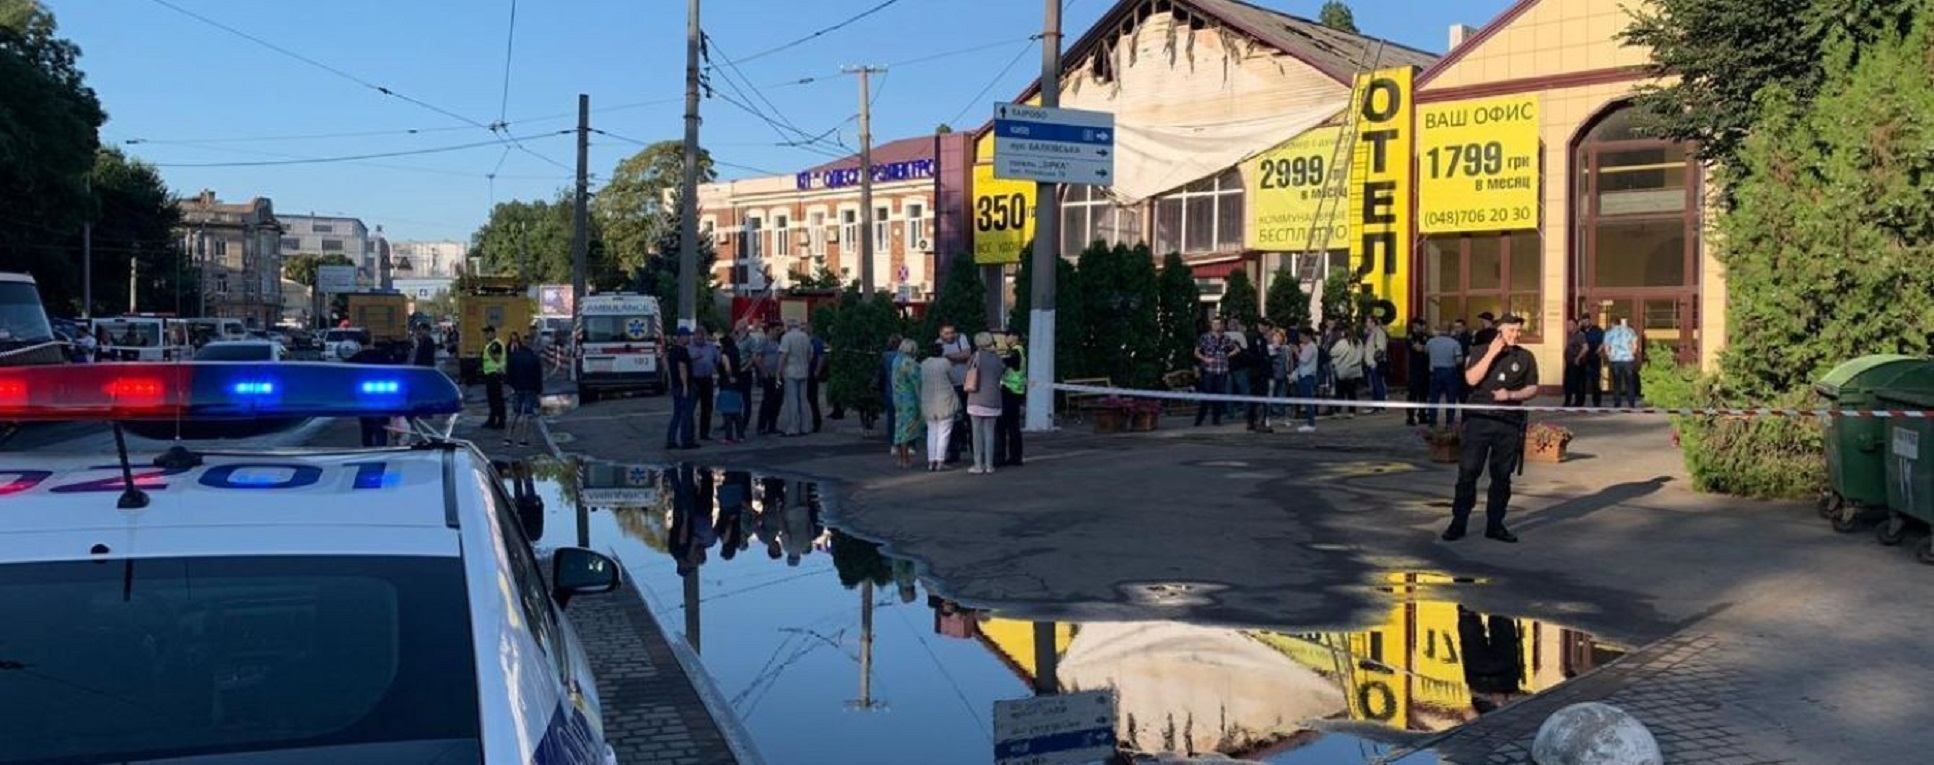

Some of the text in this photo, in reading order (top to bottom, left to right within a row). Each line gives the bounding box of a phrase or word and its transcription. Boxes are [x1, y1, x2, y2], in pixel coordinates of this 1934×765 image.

[1425, 101, 1534, 129] ВАШ ОФИС
[1260, 154, 1324, 190] 2999
[1426, 141, 1530, 180] 1799 грн
[1475, 176, 1531, 192] в месяц
[977, 192, 1026, 232] 350
[1361, 79, 1400, 326] ОТЕЛЬ
[1424, 206, 1531, 227] (048)706 20 30
[1258, 224, 1348, 242] БЕСПЛТО
[587, 304, 650, 312] AMBULANCE
